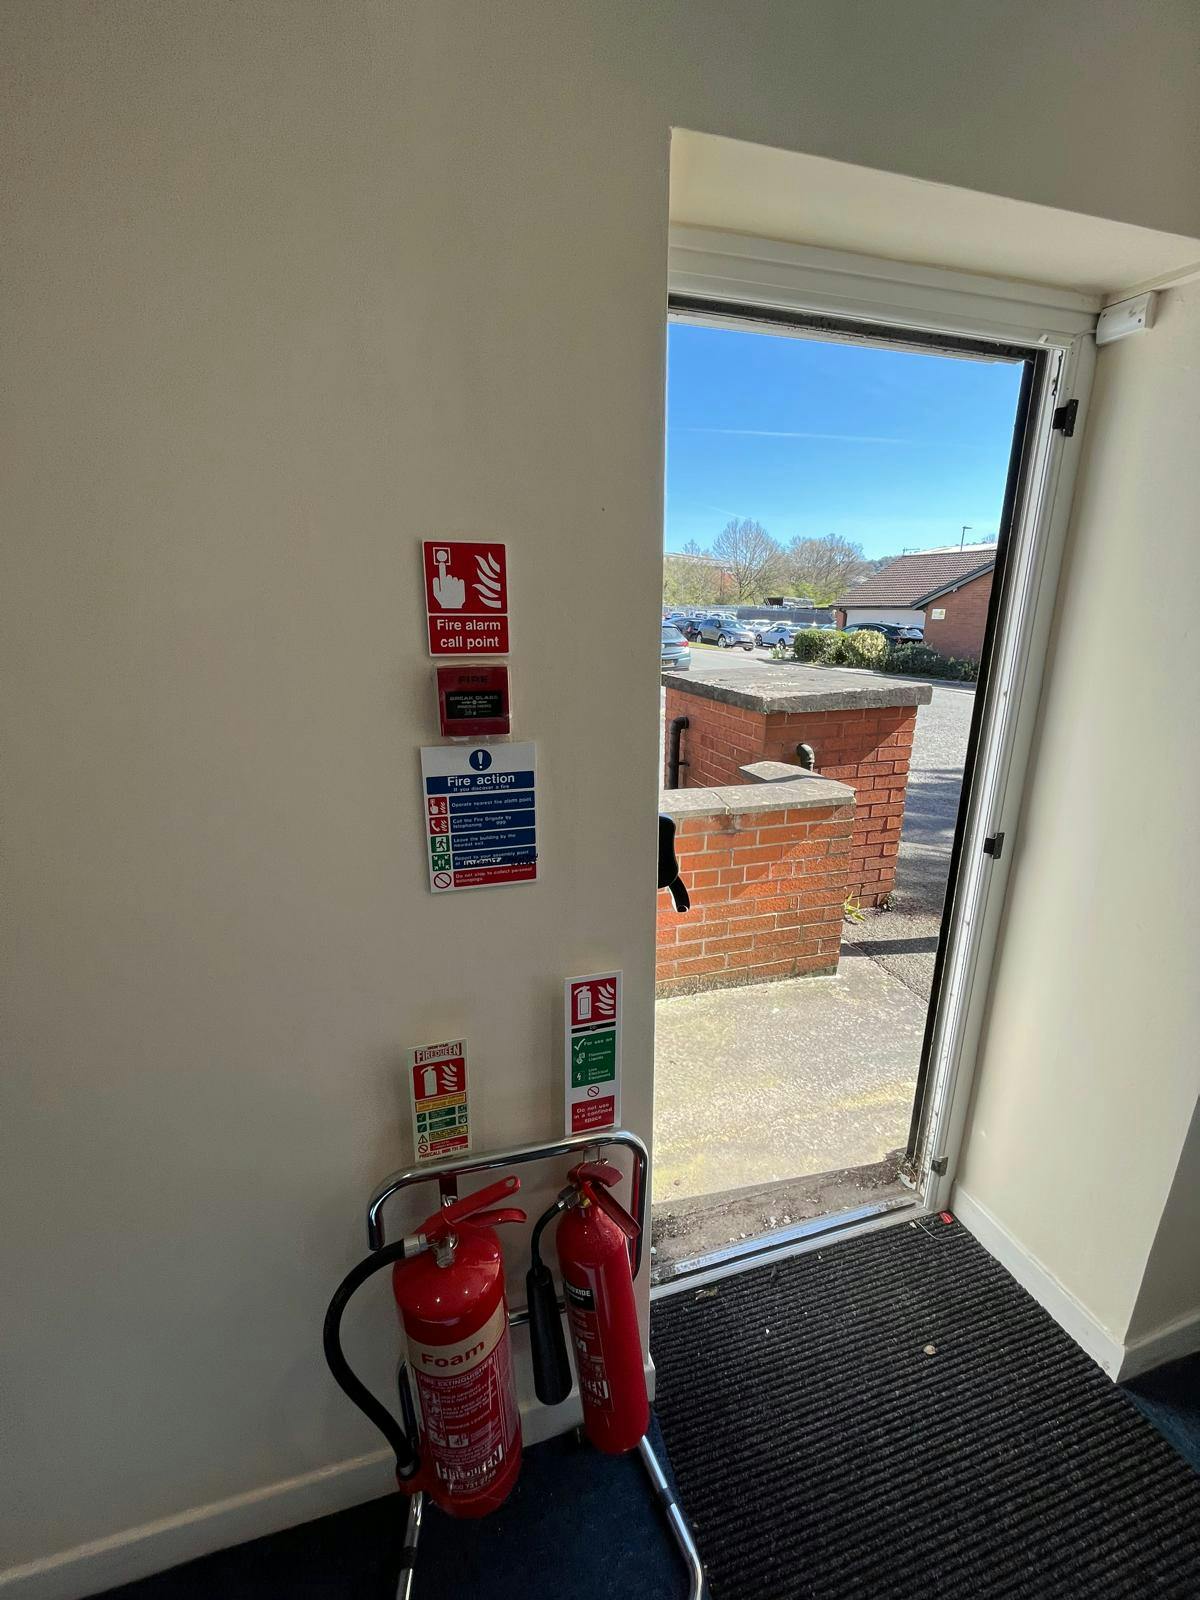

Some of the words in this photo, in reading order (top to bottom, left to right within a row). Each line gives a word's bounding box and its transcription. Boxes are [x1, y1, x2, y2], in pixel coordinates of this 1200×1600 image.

[436, 619, 462, 631] Fire
[465, 619, 501, 631] alarm
[440, 636, 463, 648] call
[467, 636, 500, 650] point
[447, 776, 471, 787] Fire
[476, 773, 515, 786] action
[421, 1341, 485, 1368] Foam
